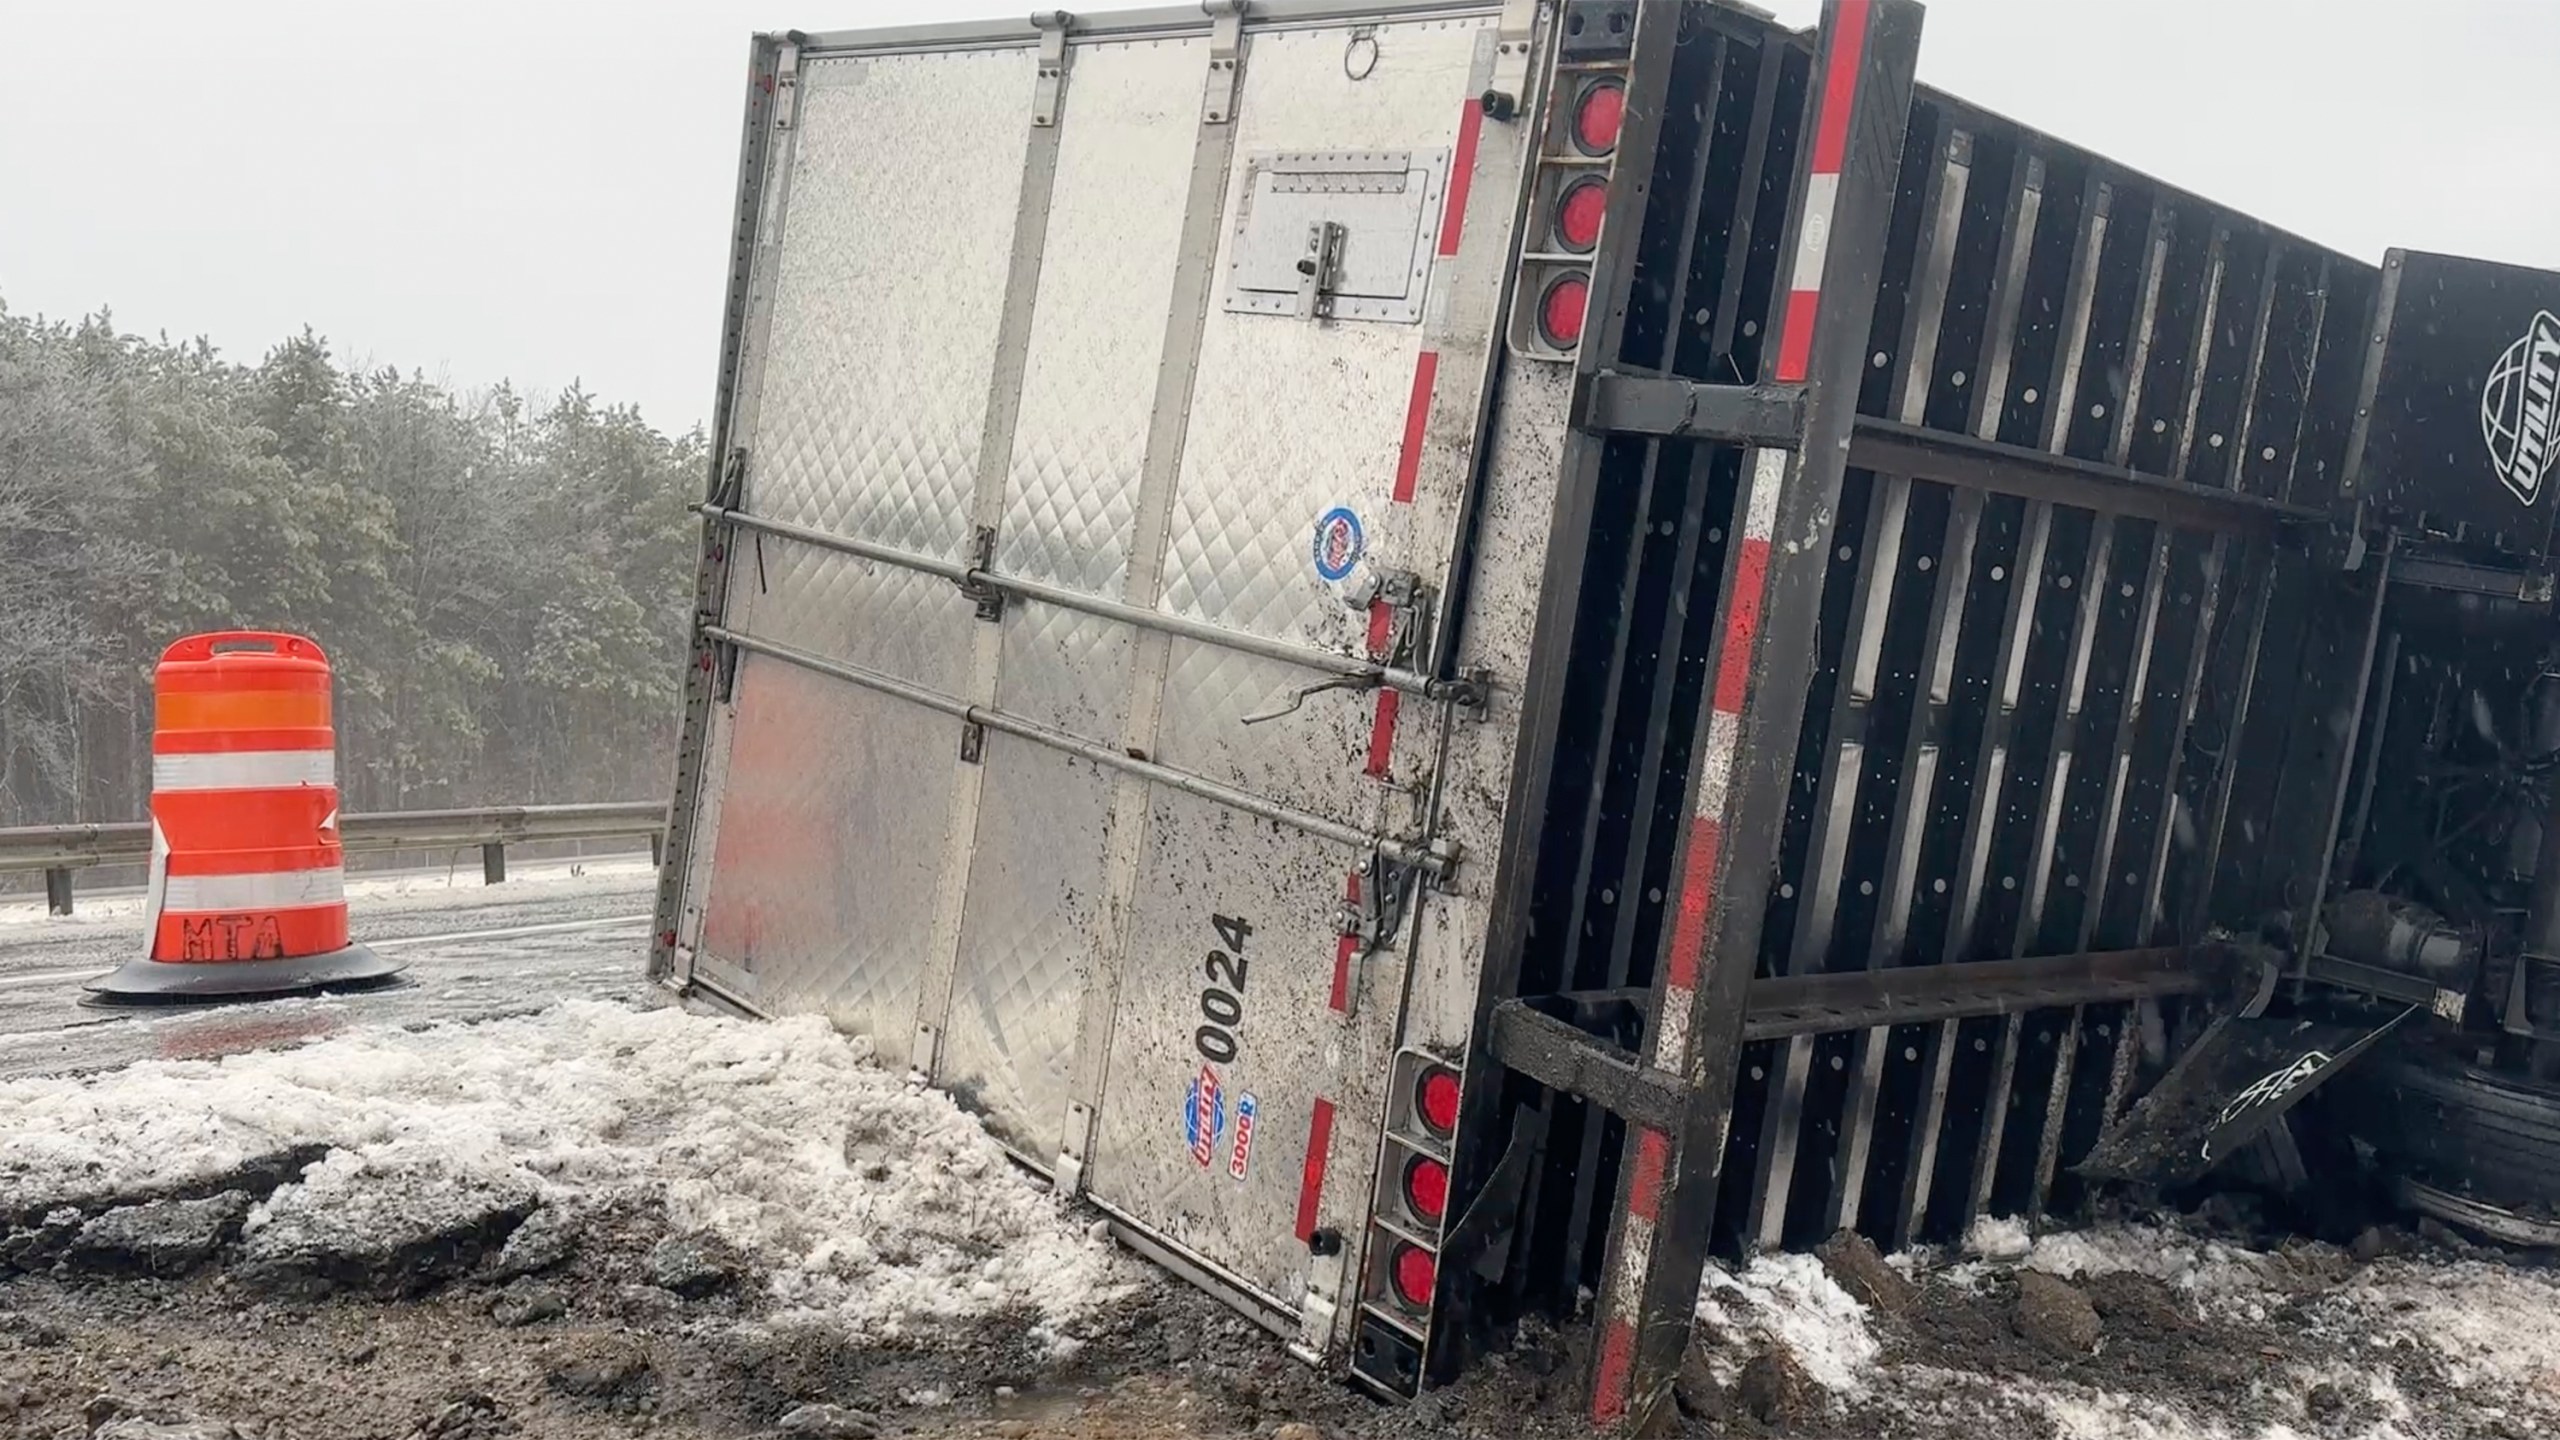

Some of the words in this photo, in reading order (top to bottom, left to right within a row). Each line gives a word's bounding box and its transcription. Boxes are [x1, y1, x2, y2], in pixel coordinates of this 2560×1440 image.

[2511, 322, 2560, 490] UTILITY
[183, 915, 284, 961] MTA
[1195, 912, 1253, 1064] 0024
[1194, 1068, 1216, 1163] UTILITY
[1230, 1100, 1255, 1175] 3000R
